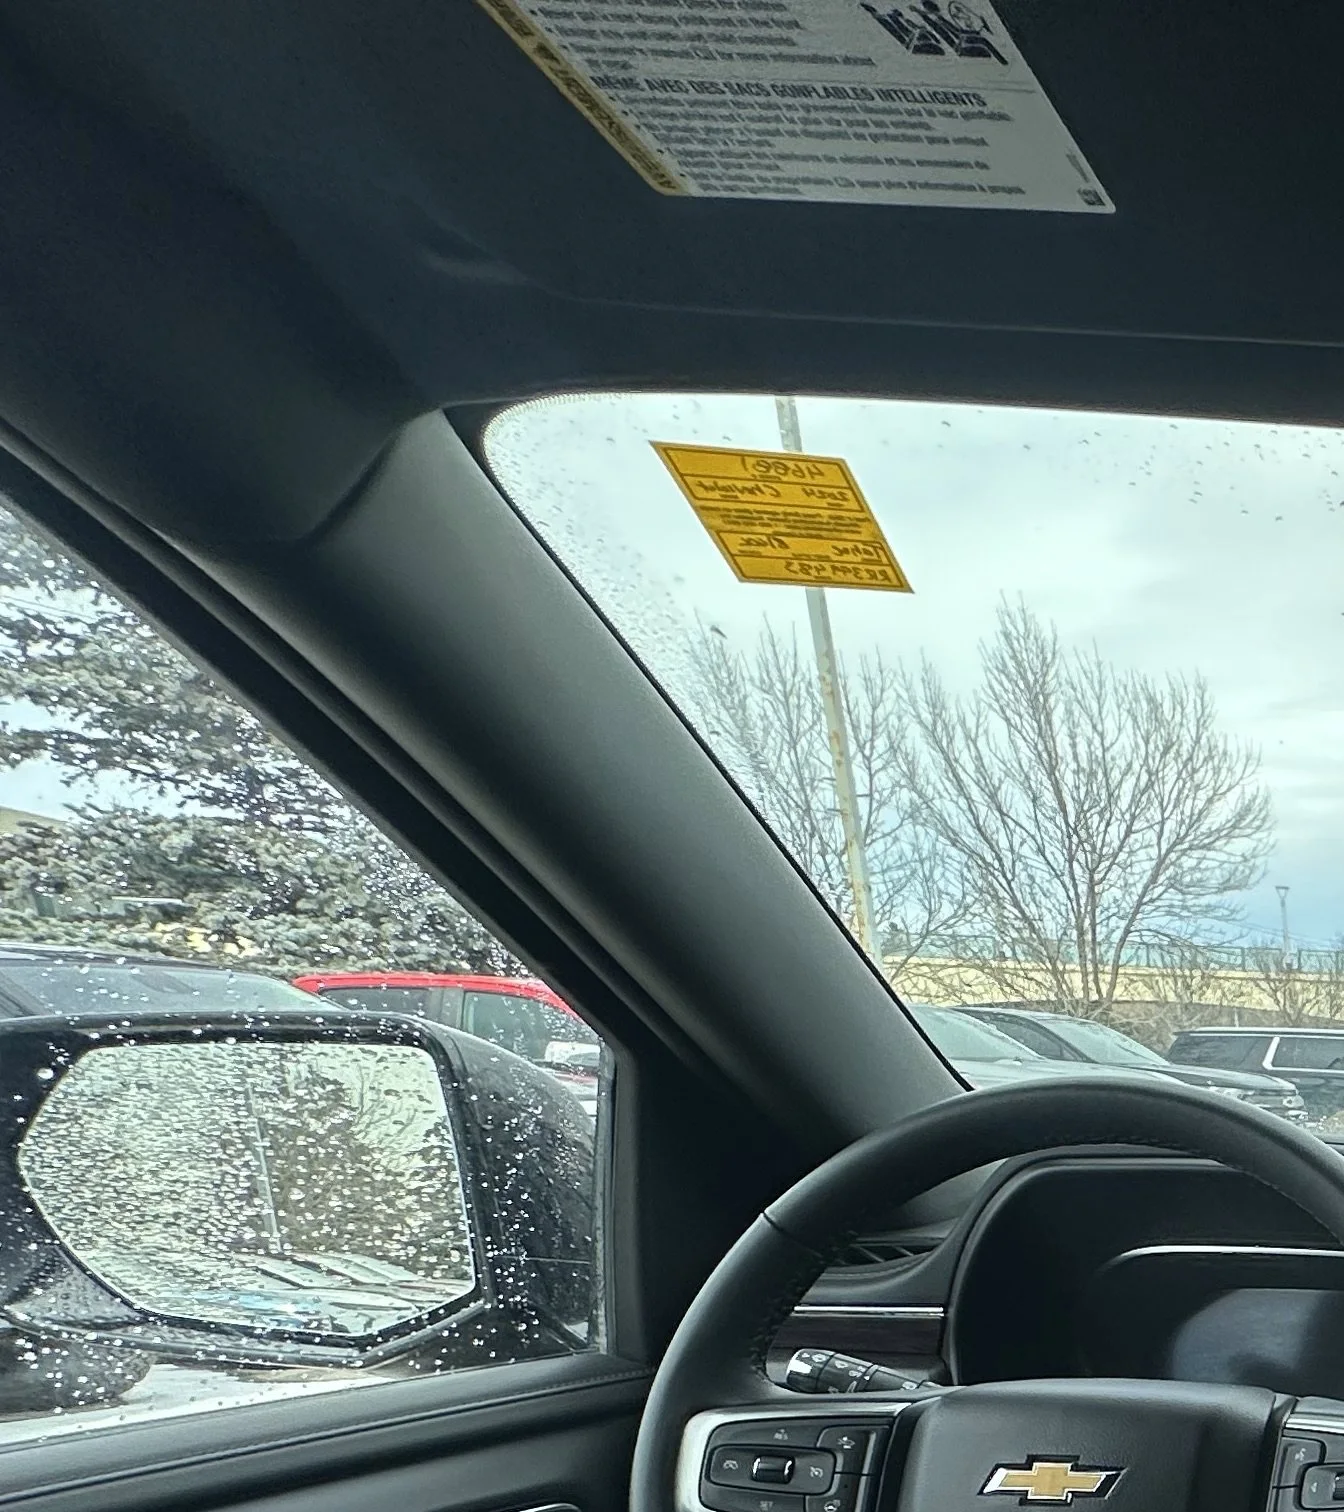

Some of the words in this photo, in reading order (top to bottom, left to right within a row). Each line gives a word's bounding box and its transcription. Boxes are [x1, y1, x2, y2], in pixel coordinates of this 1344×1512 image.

[643, 79, 688, 95] AVEC
[689, 80, 724, 96] DES
[725, 81, 770, 98] SACS
[772, 83, 874, 103] GONFLABLES
[875, 87, 986, 107] INTELLIGENTS
